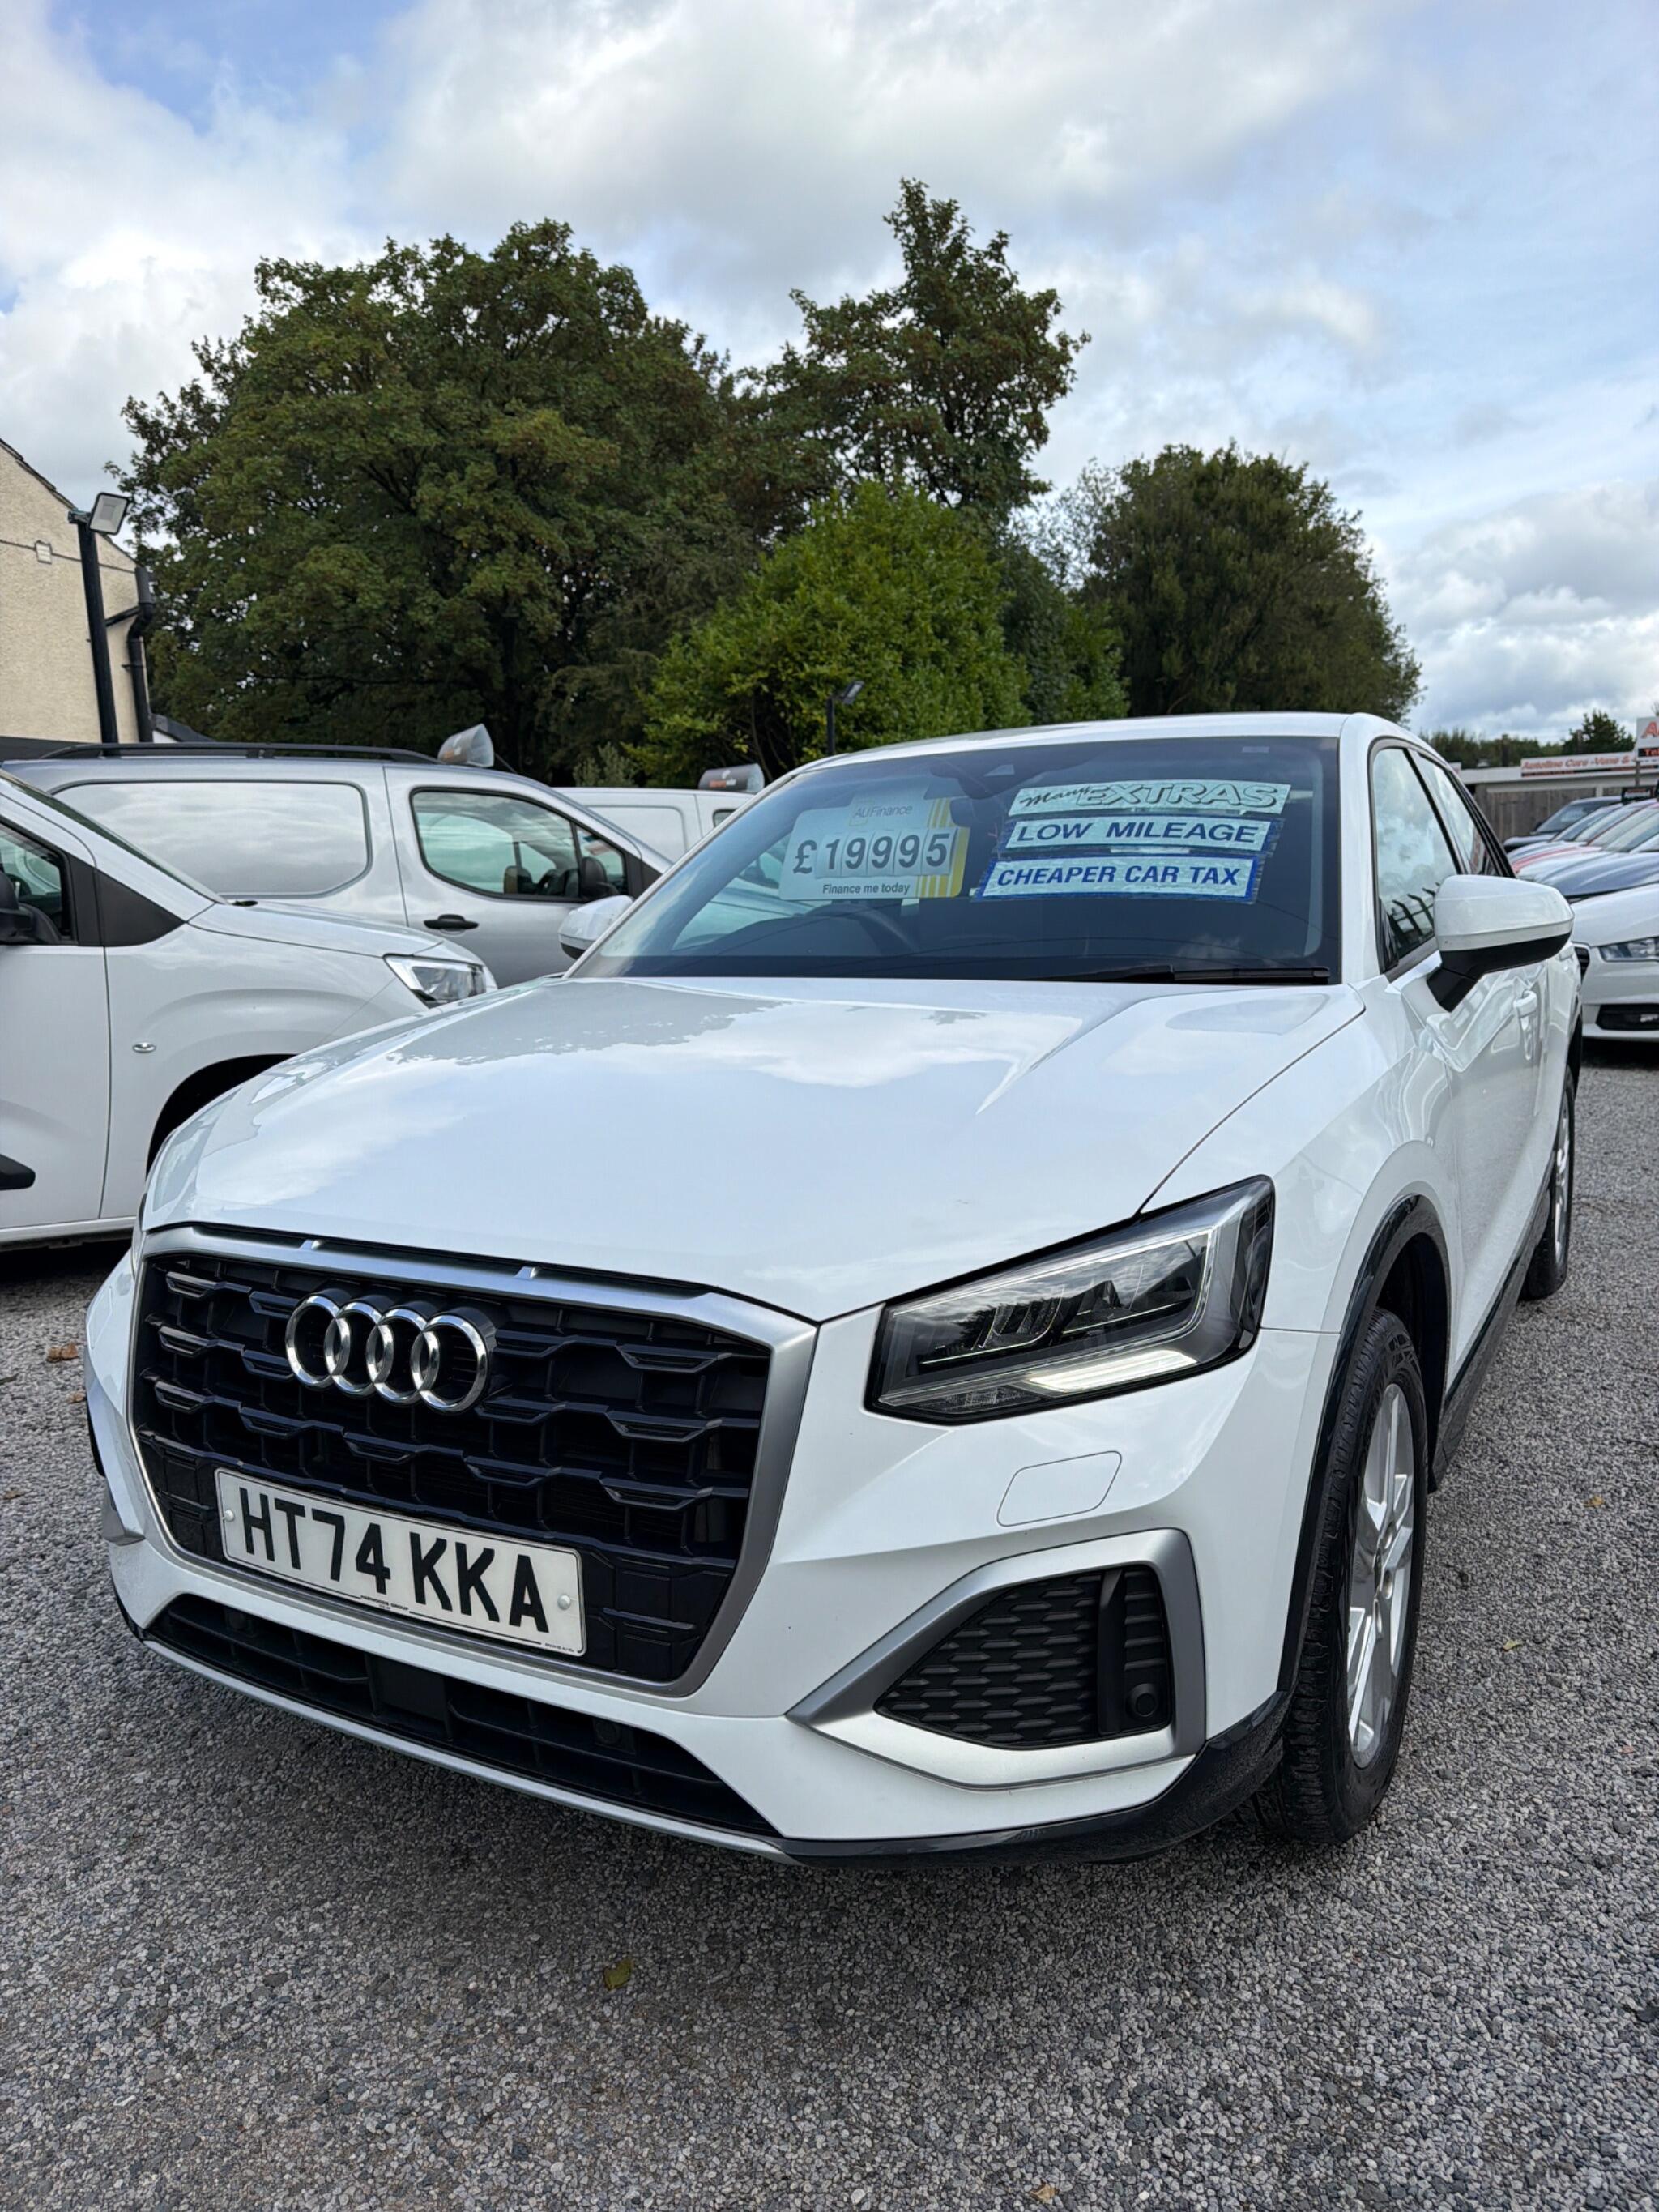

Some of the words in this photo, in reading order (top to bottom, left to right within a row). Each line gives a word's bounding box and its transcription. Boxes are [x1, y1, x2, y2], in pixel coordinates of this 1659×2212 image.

[1020, 786, 1090, 807] Many
[1076, 784, 1279, 809] EXTRAS
[1017, 822, 1093, 843] LOW
[1106, 822, 1260, 843] MILEAGE
[793, 832, 950, 875] £19995
[997, 865, 1115, 887] CHEAPER
[1124, 865, 1179, 884] CAR
[1189, 866, 1241, 886] TAX
[822, 882, 861, 895] Finance
[864, 885, 880, 894] me
[881, 882, 911, 895] today
[239, 1487, 392, 1595] HT74
[409, 1531, 550, 1634] KKA
